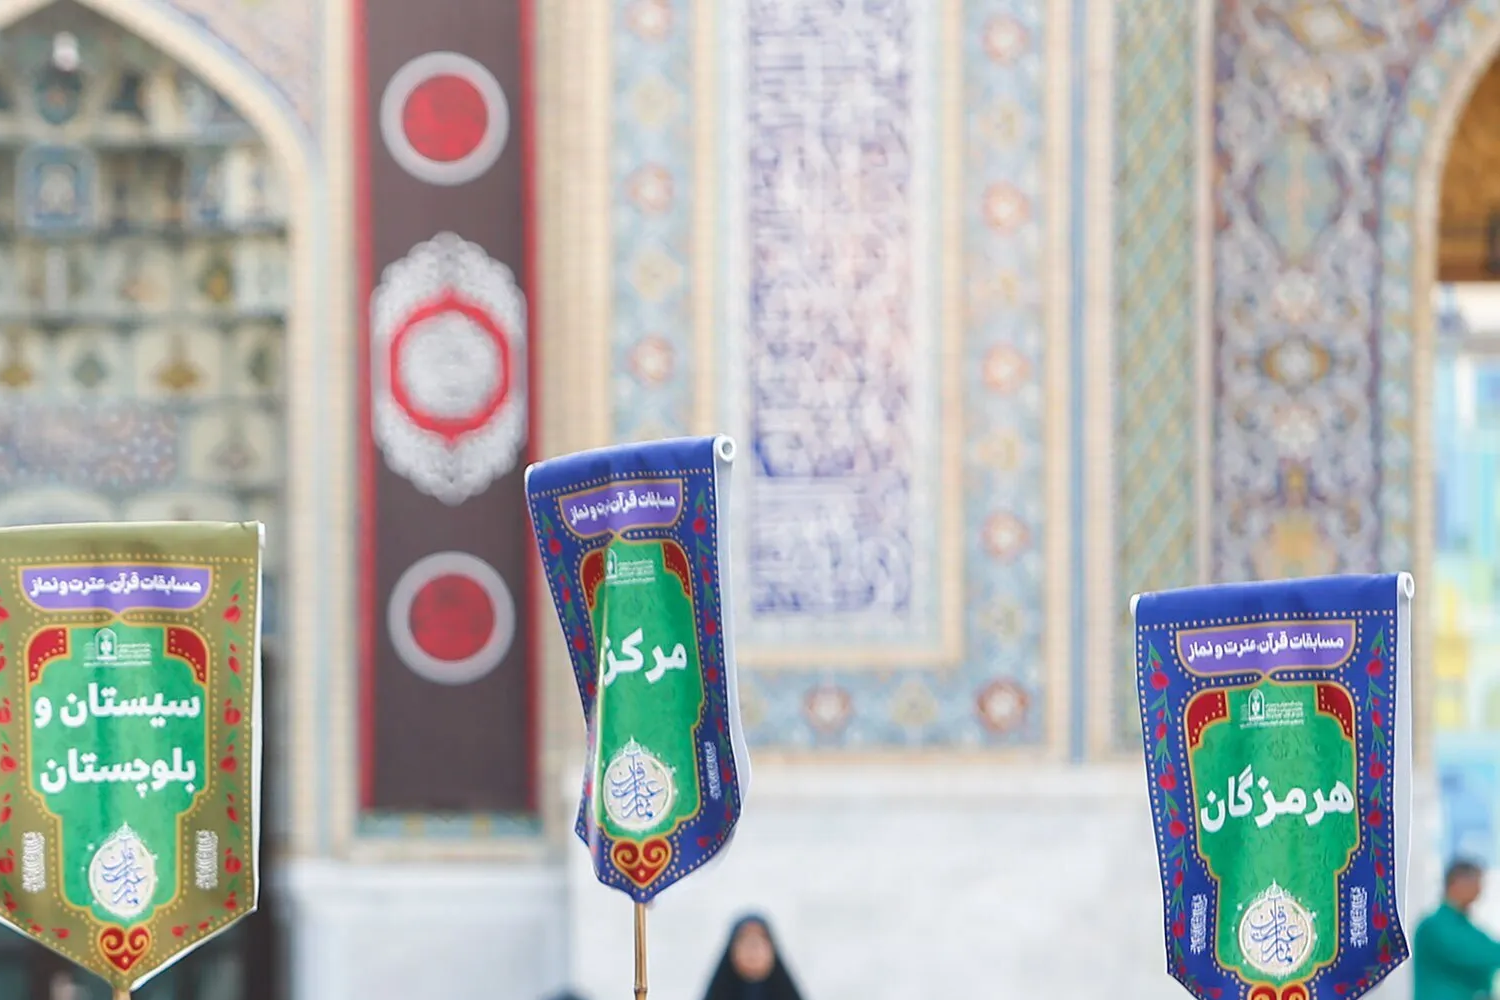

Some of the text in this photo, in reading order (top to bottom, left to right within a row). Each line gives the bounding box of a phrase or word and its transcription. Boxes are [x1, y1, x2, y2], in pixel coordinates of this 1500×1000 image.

[570, 503, 590, 526] نماز
[590, 505, 598, 522] و
[30, 576, 58, 598] نماز
[58, 580, 69, 596] و
[69, 577, 105, 596] عترت
[140, 574, 202, 596] مسابقات
[1187, 640, 1214, 664] نماز
[1214, 643, 1223, 660] و
[1224, 638, 1256, 658] عترت
[1289, 632, 1345, 654] مسابقات
[603, 626, 688, 688] مرکز
[34, 682, 201, 729] سیستان و
[40, 747, 197, 798] بلوچستان
[1200, 764, 1355, 833] هرمزگان
